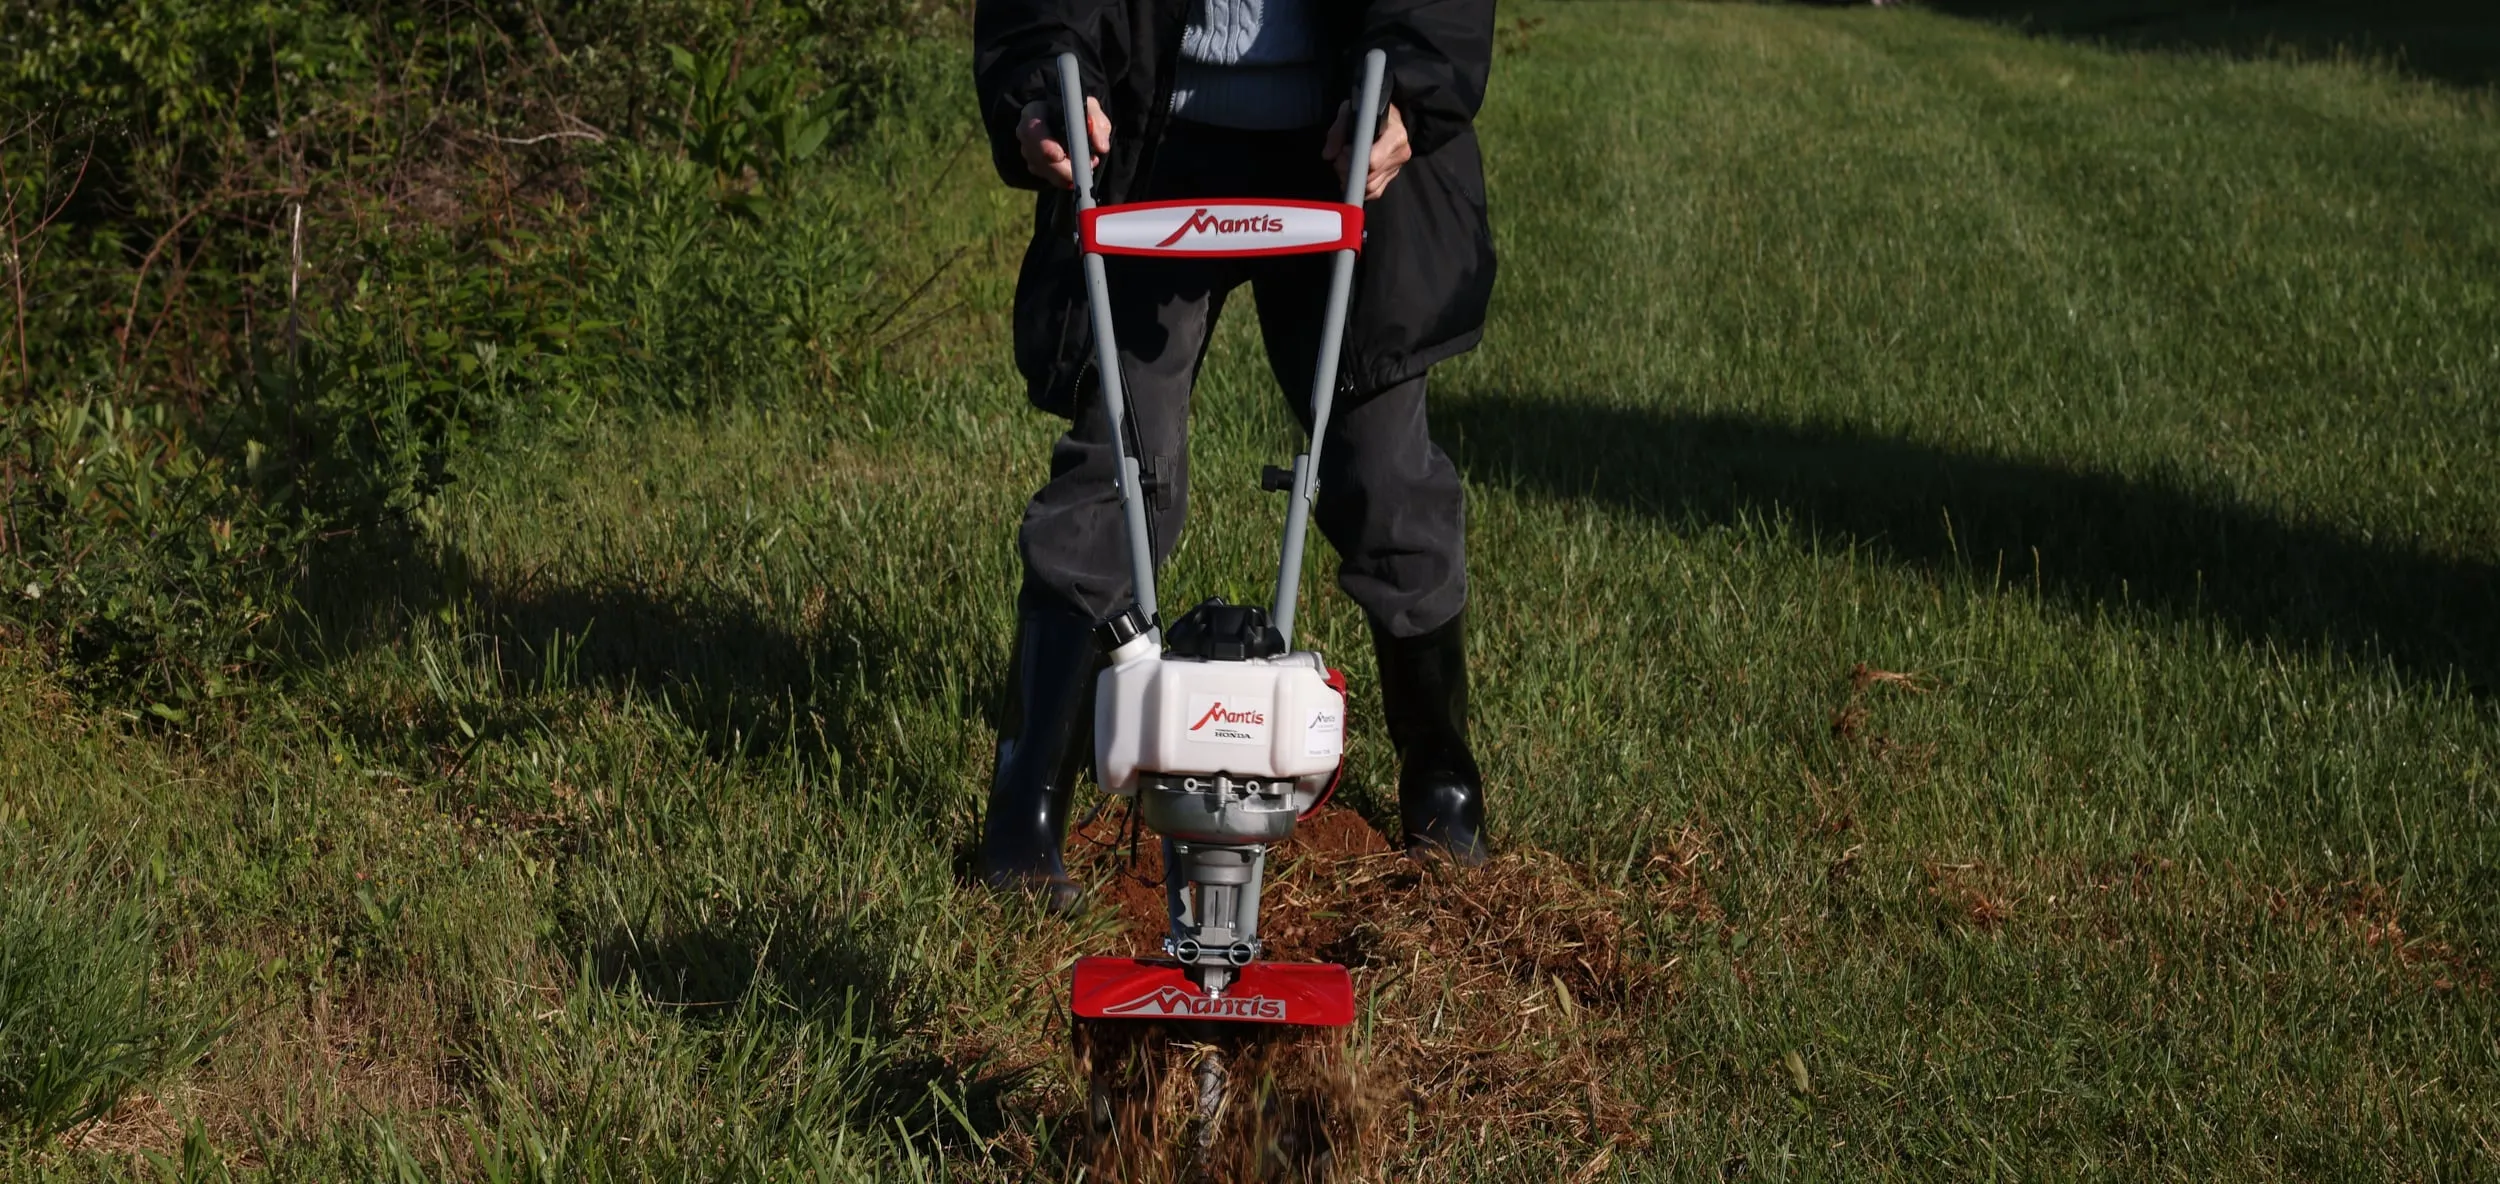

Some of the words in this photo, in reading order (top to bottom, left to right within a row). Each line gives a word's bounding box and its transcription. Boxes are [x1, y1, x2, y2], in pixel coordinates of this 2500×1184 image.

[1155, 209, 1284, 247] Mantis
[1190, 702, 1264, 731] Mantis
[1215, 731, 1251, 739] HONDA
[1106, 987, 1280, 1018] Mantis
